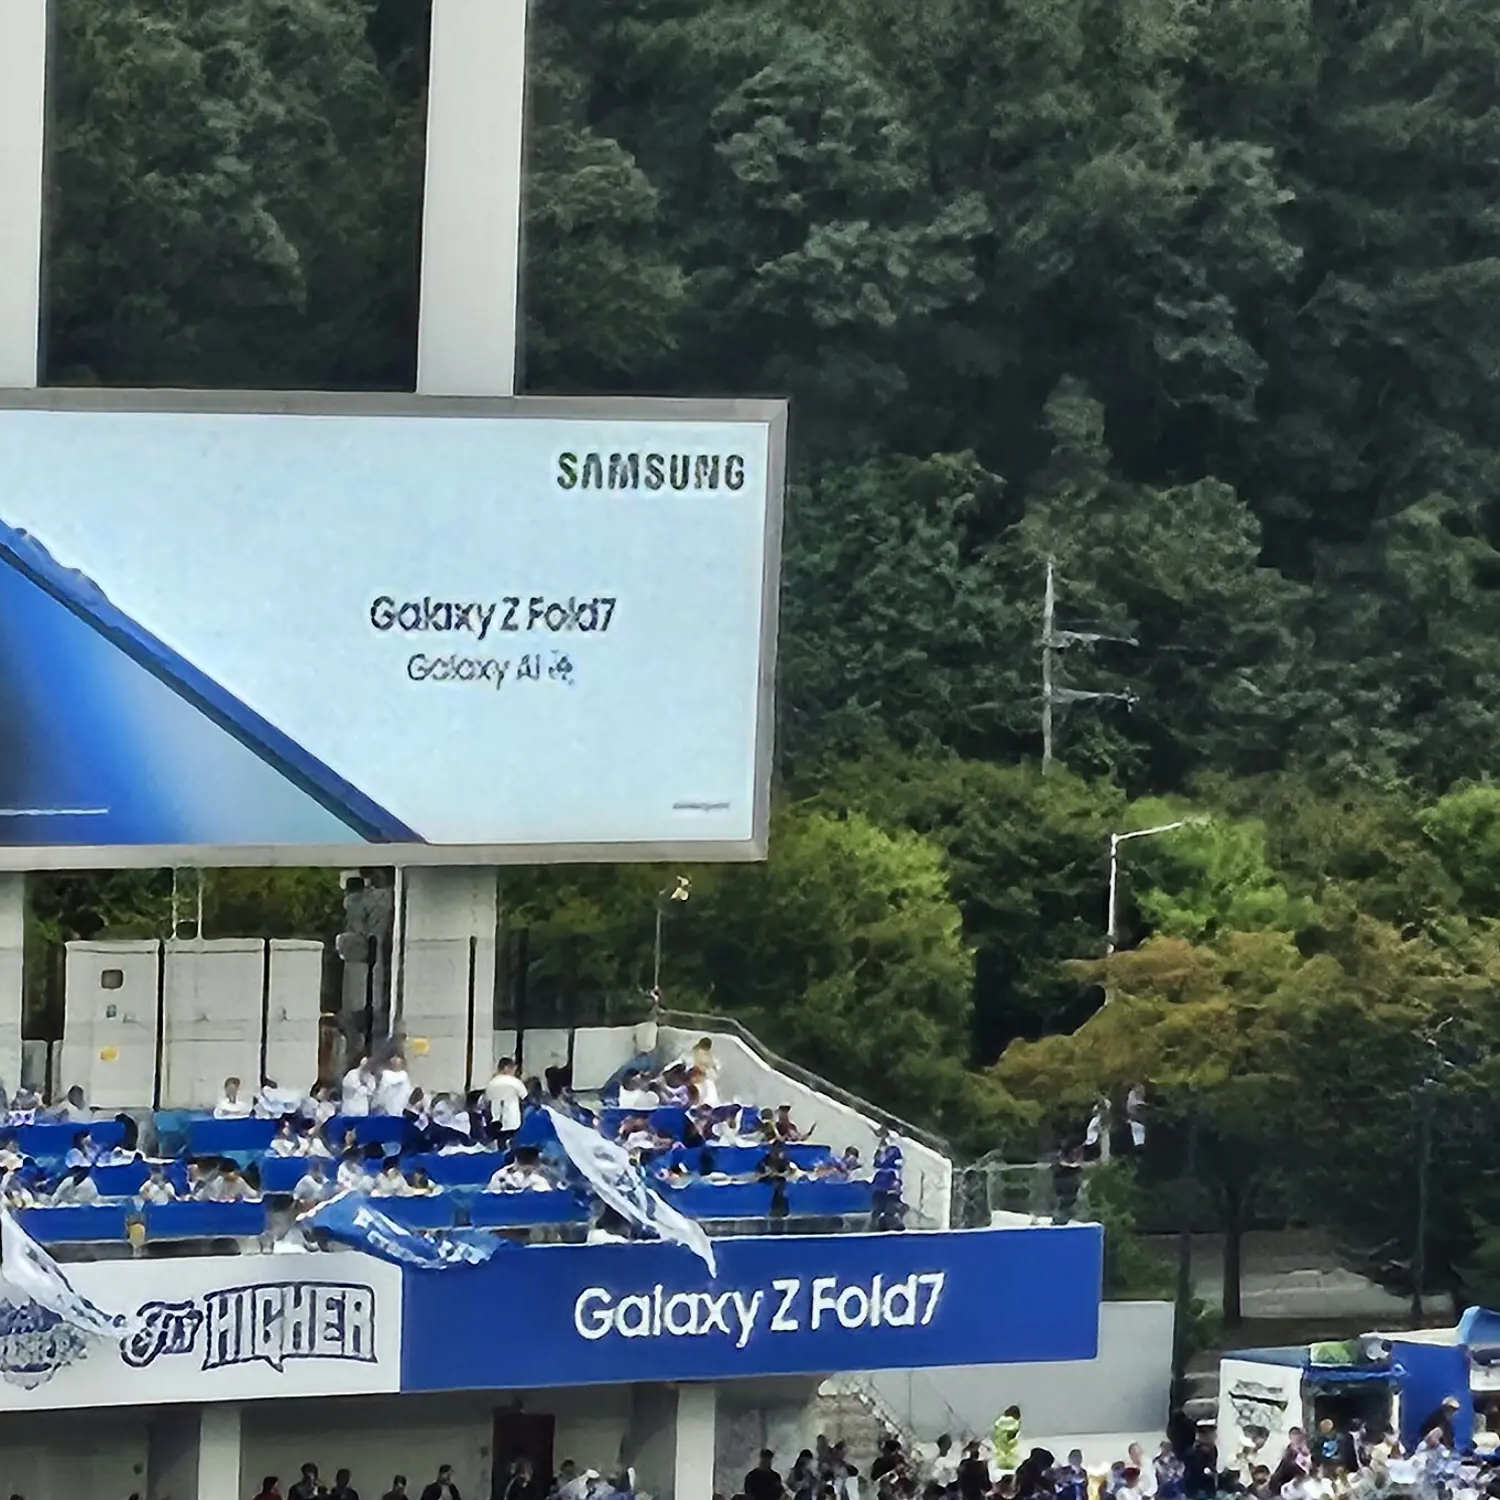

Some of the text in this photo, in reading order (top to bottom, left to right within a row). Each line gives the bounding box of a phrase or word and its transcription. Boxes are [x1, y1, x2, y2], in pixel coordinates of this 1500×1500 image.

[556, 451, 745, 491] SAMSUNG
[370, 595, 617, 641] Galaxy Z Fold7
[406, 652, 510, 691] Galaxy
[205, 1284, 378, 1367] HIGHER
[573, 1271, 946, 1350] Galaxy Z Fold7
